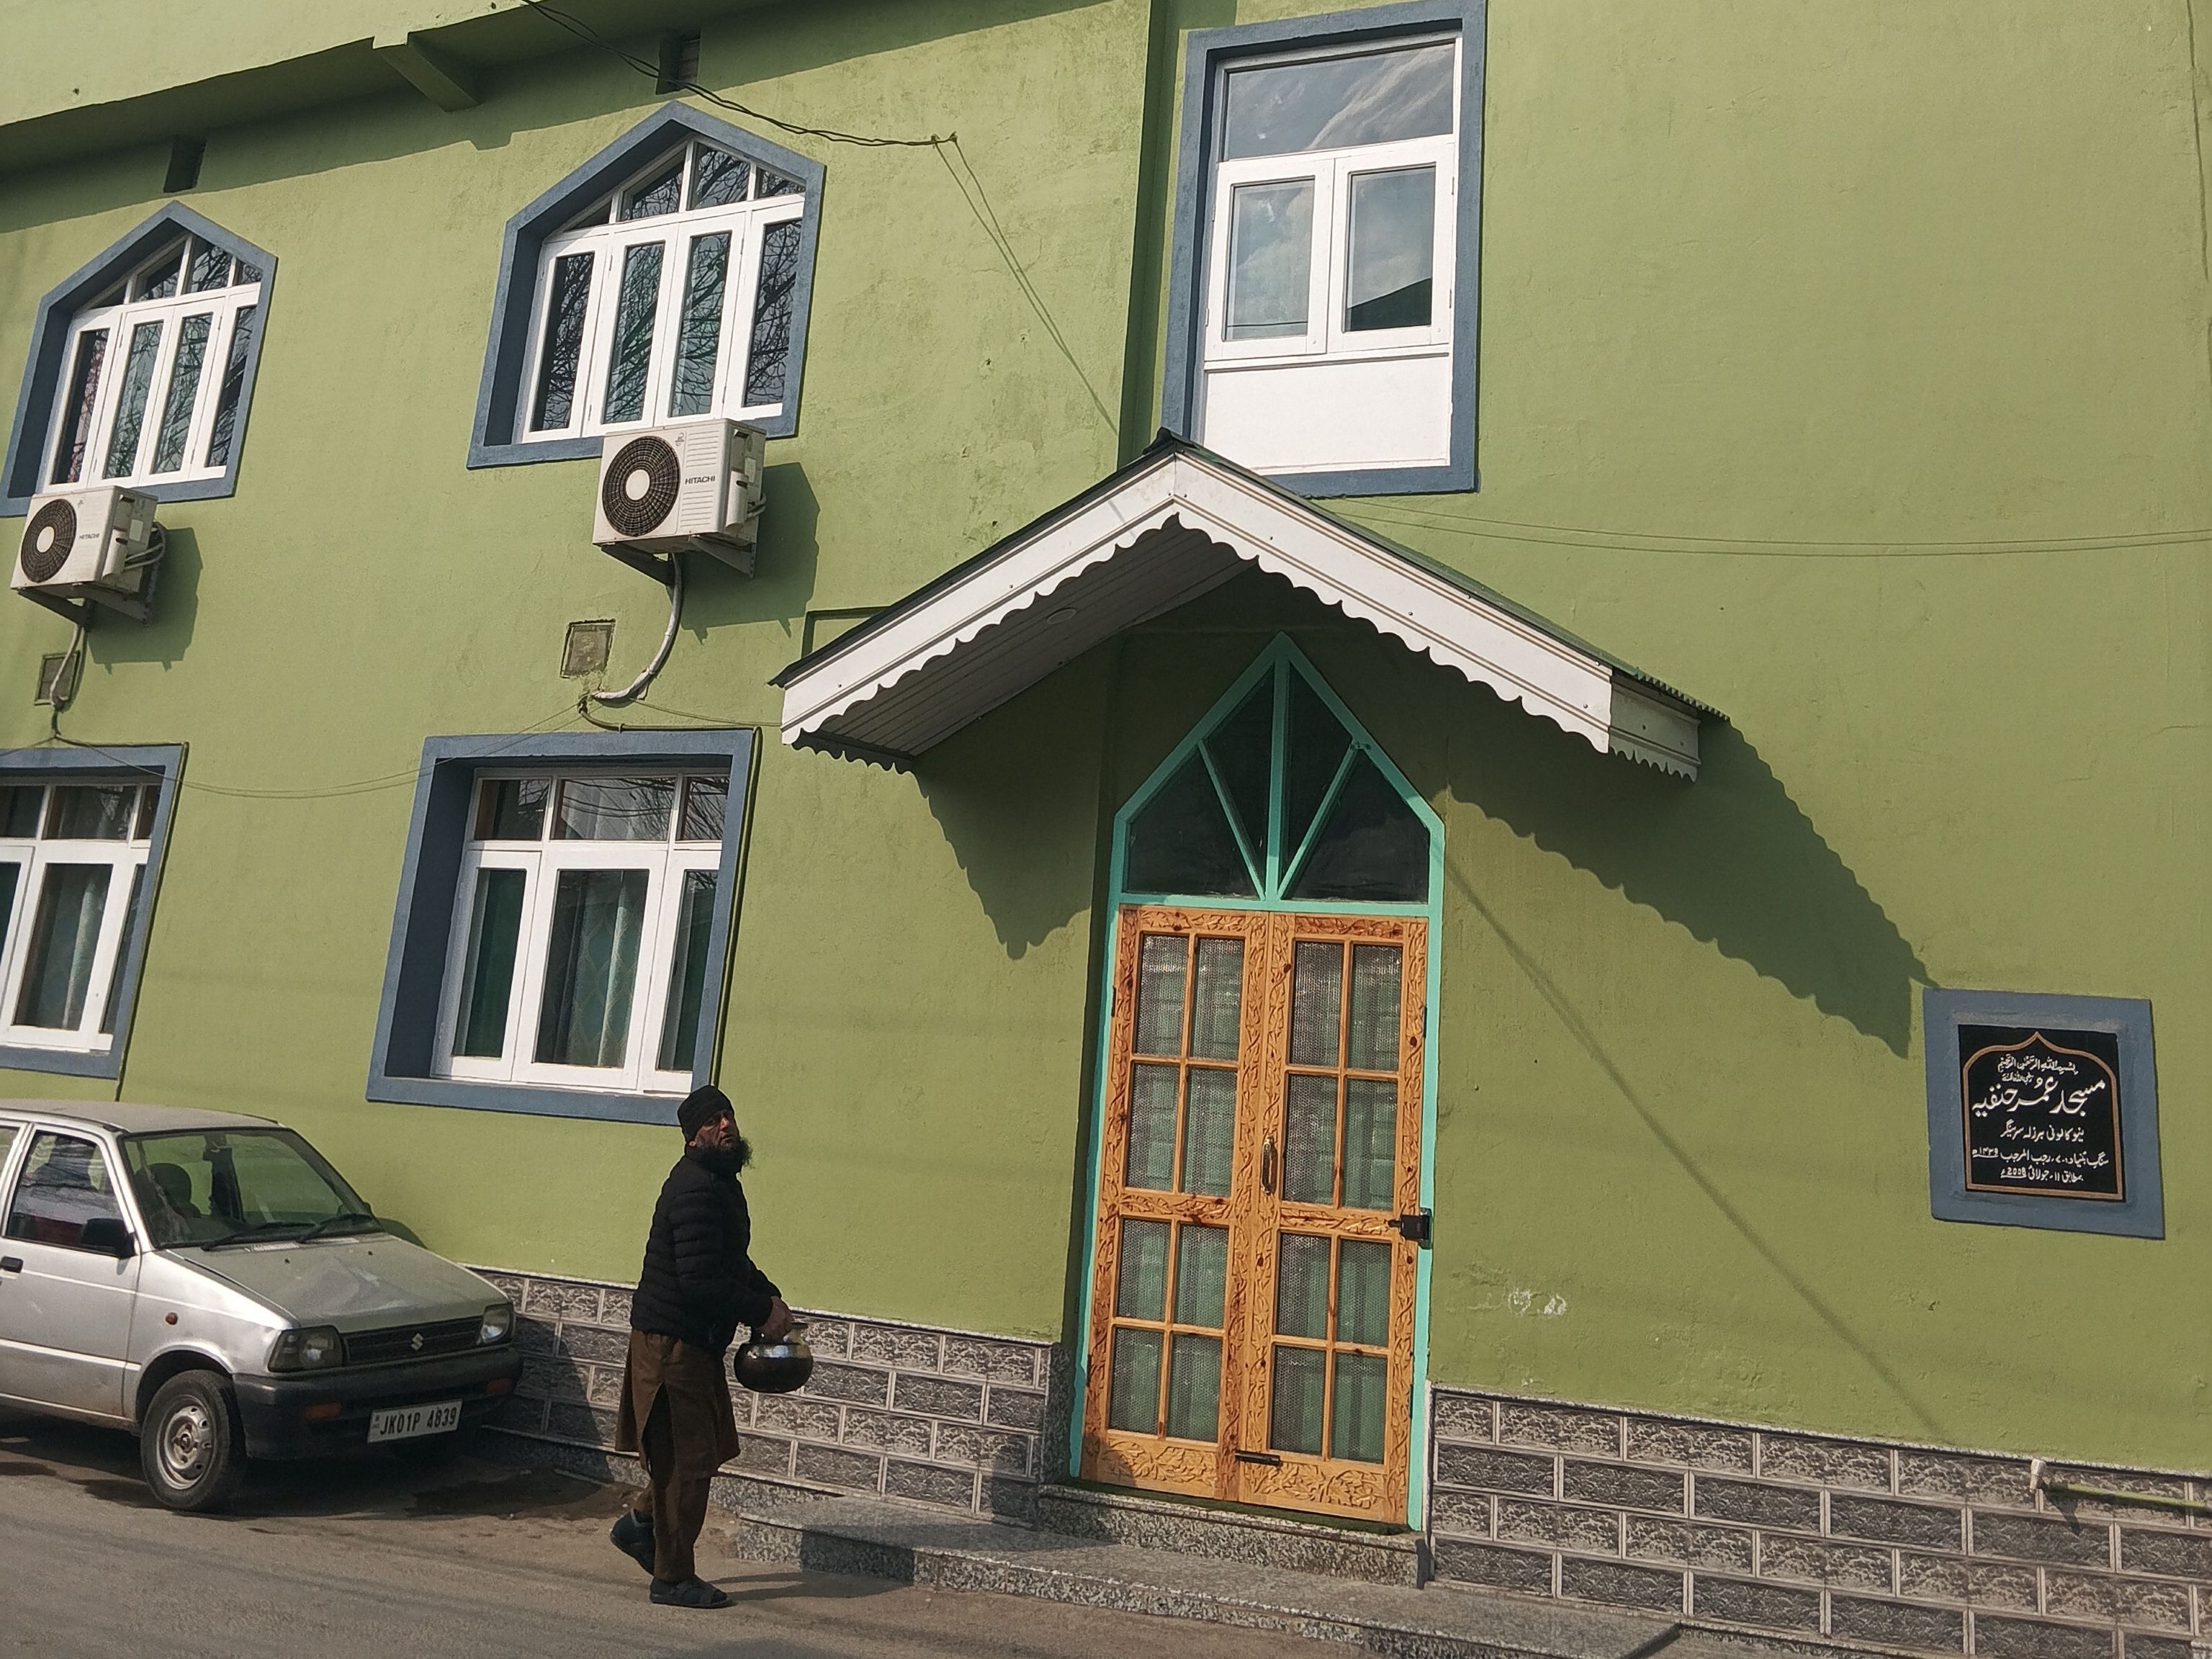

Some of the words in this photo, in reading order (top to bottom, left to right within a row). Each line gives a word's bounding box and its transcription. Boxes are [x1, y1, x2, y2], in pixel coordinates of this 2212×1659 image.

[685, 475, 716, 485] HITACHI
[2049, 1079, 2106, 1117] مسجد
[380, 1412, 421, 1435] JK01P
[426, 1406, 457, 1428] 4839
